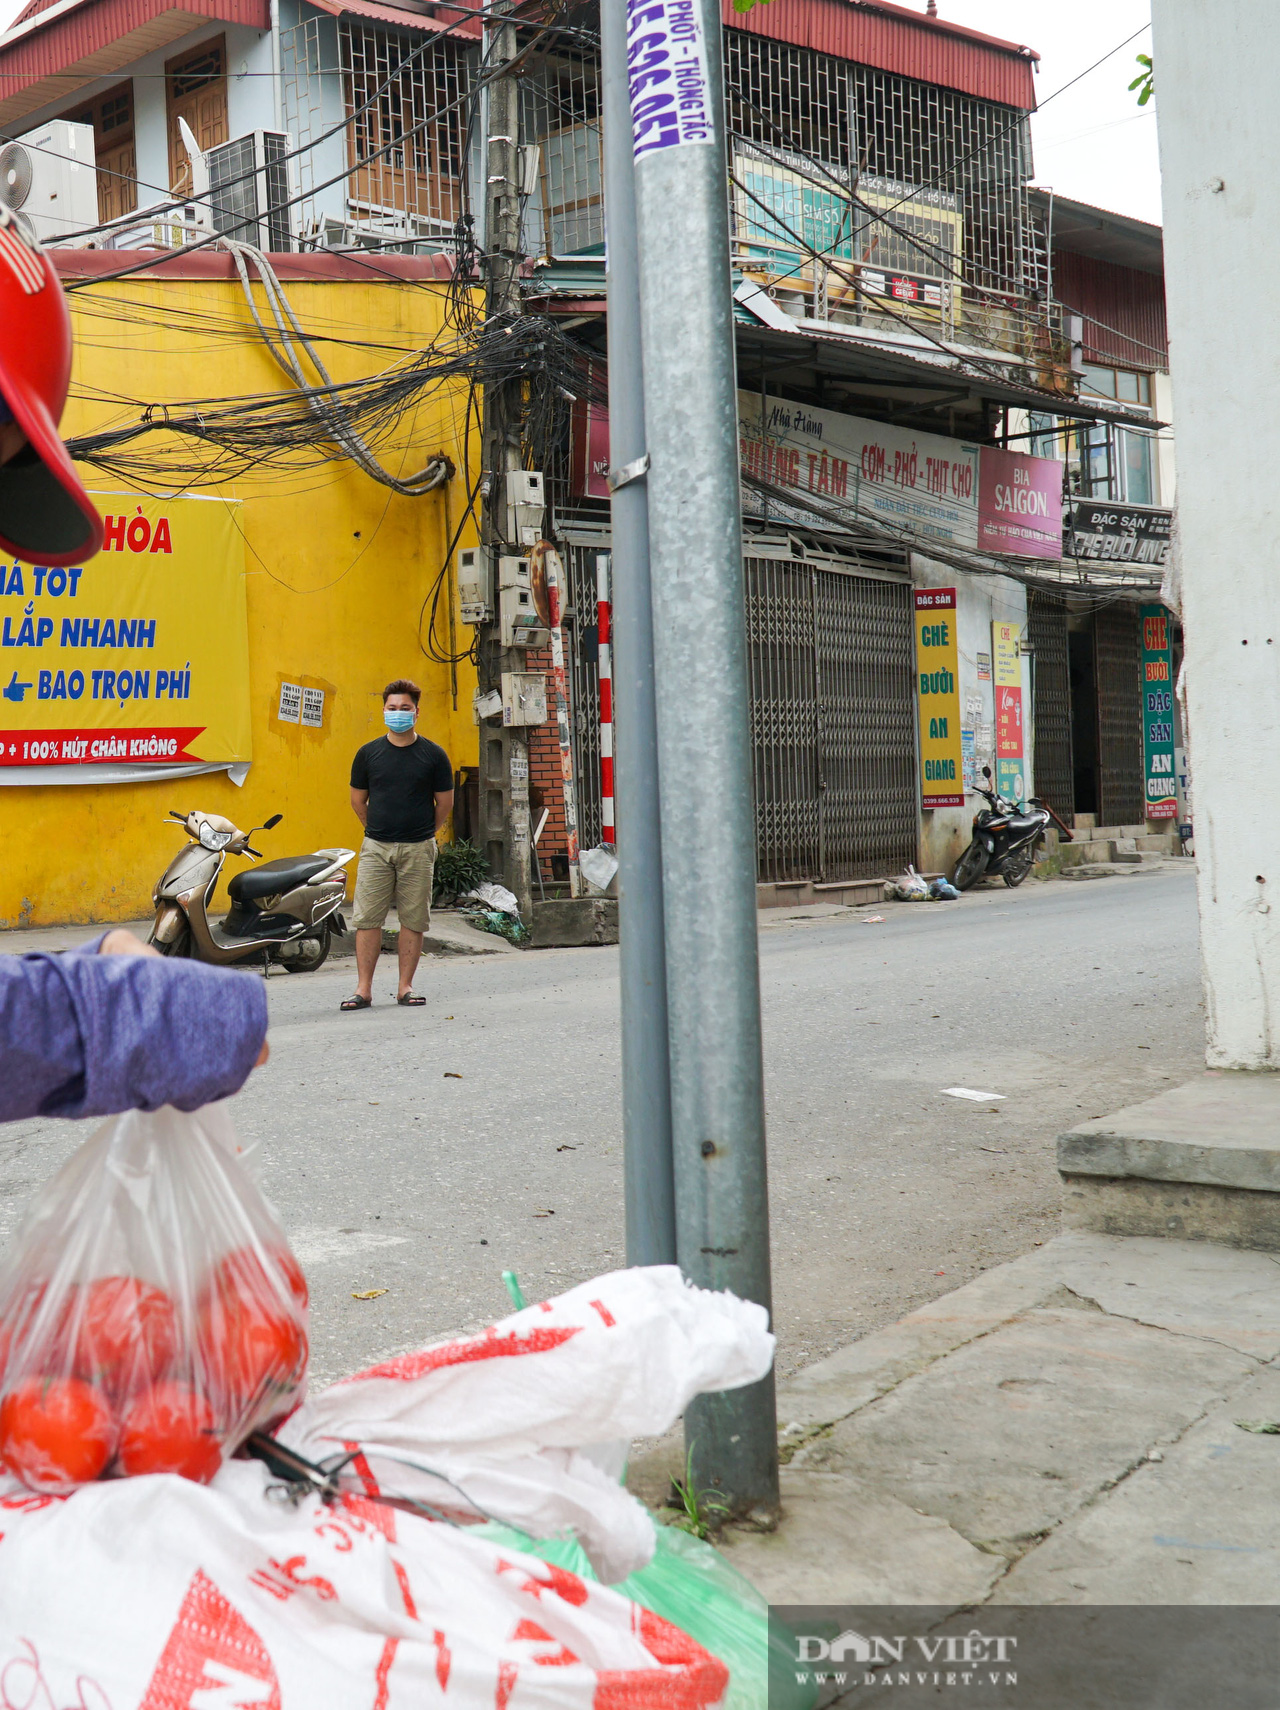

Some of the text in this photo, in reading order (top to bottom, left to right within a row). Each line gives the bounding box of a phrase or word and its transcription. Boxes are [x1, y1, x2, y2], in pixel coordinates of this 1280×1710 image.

[674, 57, 705, 110] THÔNG
[681, 112, 714, 140] TẮC
[767, 405, 823, 440] Nhà Hàng
[807, 449, 847, 497] TÂM
[861, 443, 885, 482] CƠM
[894, 441, 918, 488] PHỞ
[926, 457, 949, 501] THỊT
[952, 457, 972, 498] CHÓ
[1014, 468, 1030, 486] BIA
[995, 484, 1047, 517] SAIGON
[102, 505, 173, 553] HÒA
[1091, 512, 1118, 526] ĐẶC
[1120, 513, 1147, 528] SẢN
[935, 593, 951, 604] SẢN
[2, 601, 156, 648] LẮP NHANH
[921, 620, 949, 647] CHÈ
[1144, 609, 1168, 650] CHÈ
[38, 661, 191, 708] BAO TRỌN PHÍ
[920, 667, 954, 694] BƯỞI
[1148, 689, 1171, 715] ĐẶC
[929, 717, 948, 739] AN
[1150, 719, 1171, 742] SẢN
[23, 741, 58, 759] 100%
[62, 737, 88, 757] HÚT
[90, 735, 128, 757] CHÂN
[129, 735, 177, 756] KHÔNG
[925, 759, 956, 781] GIANG
[1151, 754, 1172, 773] AN
[1147, 777, 1175, 797] GIANG
